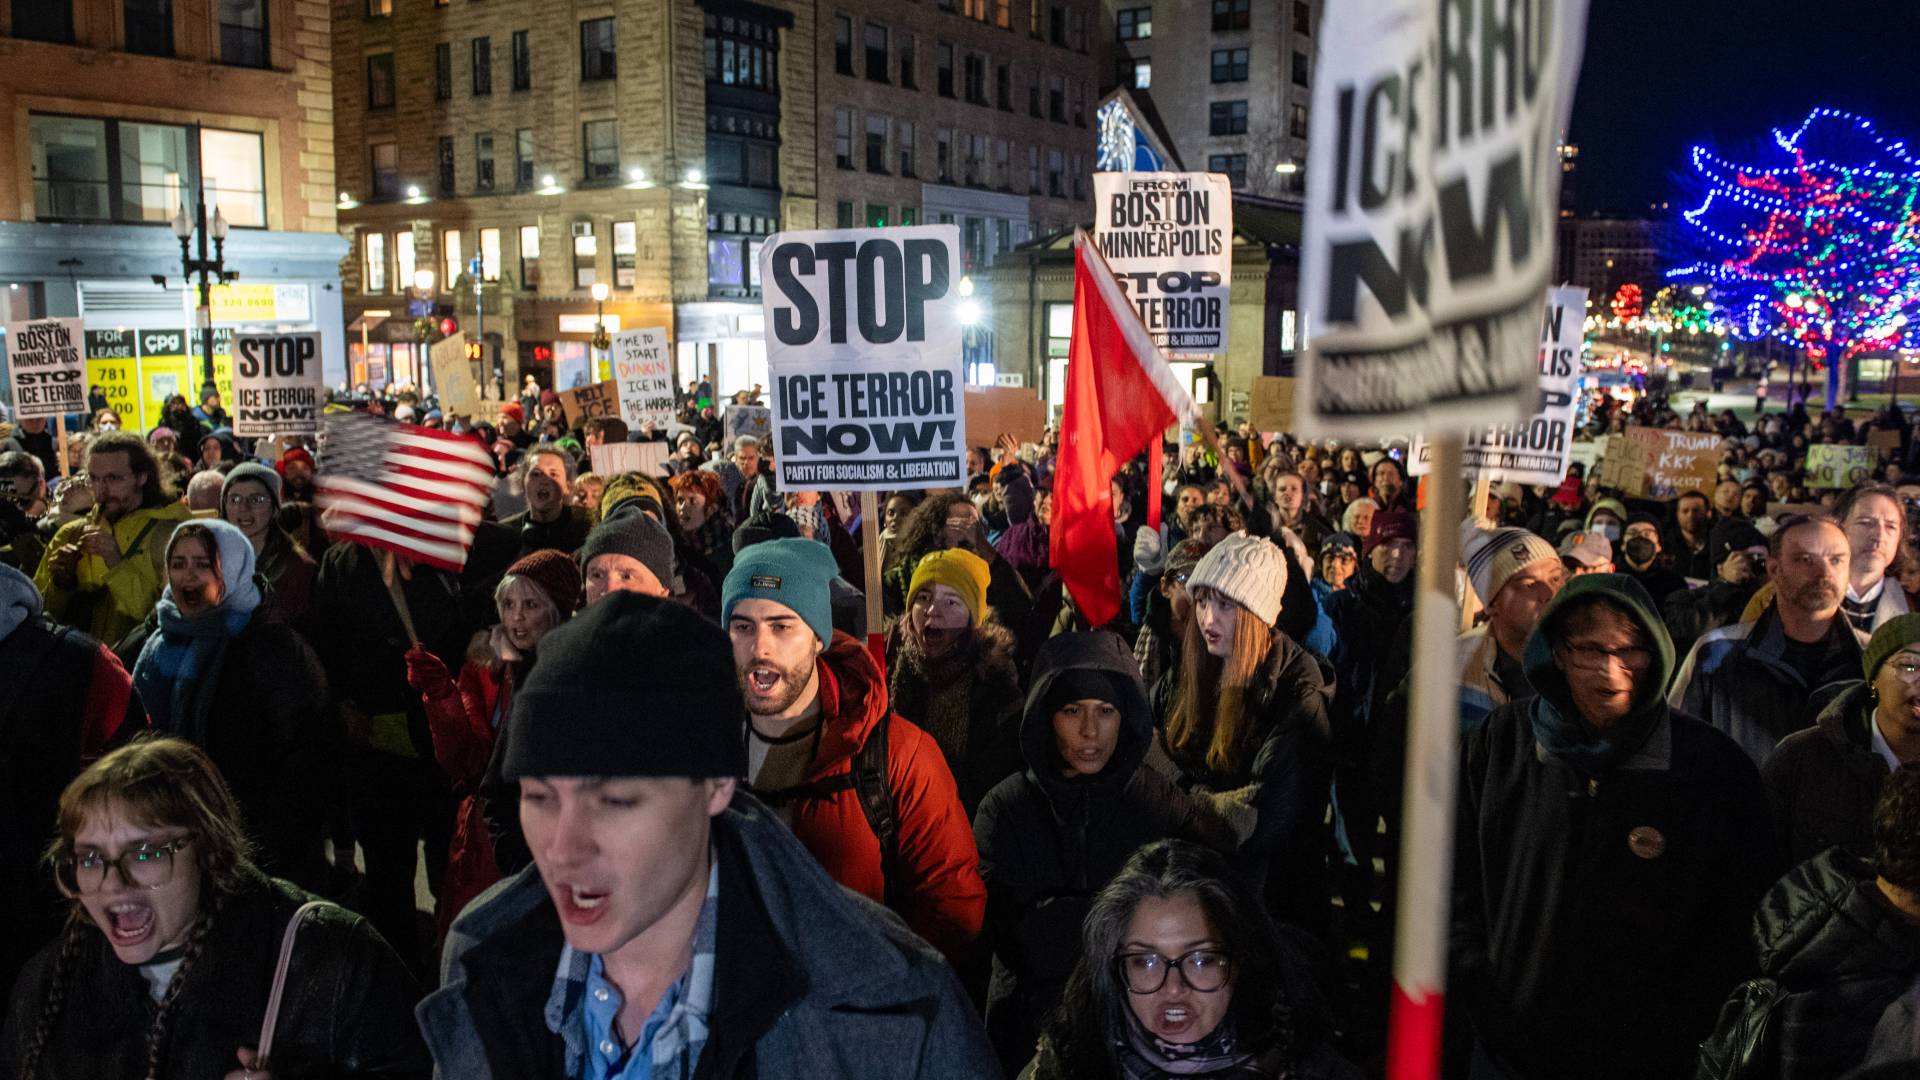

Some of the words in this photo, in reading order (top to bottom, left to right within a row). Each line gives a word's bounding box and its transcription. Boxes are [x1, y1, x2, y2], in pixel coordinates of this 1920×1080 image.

[1133, 180, 1188, 191] FROM
[1111, 191, 1210, 228] BOSTON
[1148, 222, 1174, 232] TO
[1100, 229, 1222, 259] MINNEAPOLIS
[772, 238, 950, 346] STOP
[1135, 297, 1221, 329] TERROR
[17, 328, 71, 351] BOSTON
[97, 330, 123, 342] FOR
[643, 334, 654, 344] TO
[1180, 333, 1219, 346] LIBERATION
[13, 347, 79, 368] MINNEAPOLIS
[90, 346, 130, 358] LEASE
[239, 336, 315, 378] STOP
[626, 348, 660, 361] START
[16, 370, 82, 385] STOP
[98, 368, 126, 380] 781
[619, 361, 666, 379] DUNKIN
[18, 386, 40, 404] ICE
[41, 384, 83, 402] TERROR
[627, 380, 650, 393] ICE
[653, 379, 667, 390] IN
[778, 373, 829, 421] ICE
[832, 369, 955, 418] TERROR
[239, 389, 261, 407] ICE
[264, 387, 316, 406] TERROR
[624, 398, 643, 412] THE
[240, 407, 316, 421] NOW!
[781, 421, 956, 456] NOW!
[1664, 431, 1720, 450] TRUMP
[785, 465, 816, 481] PARTY
[817, 465, 837, 480] FOR
[836, 463, 884, 480] SOCIALISM
[886, 464, 899, 479] &
[901, 461, 956, 478] LIBERATION
[1660, 453, 1697, 471] KKK
